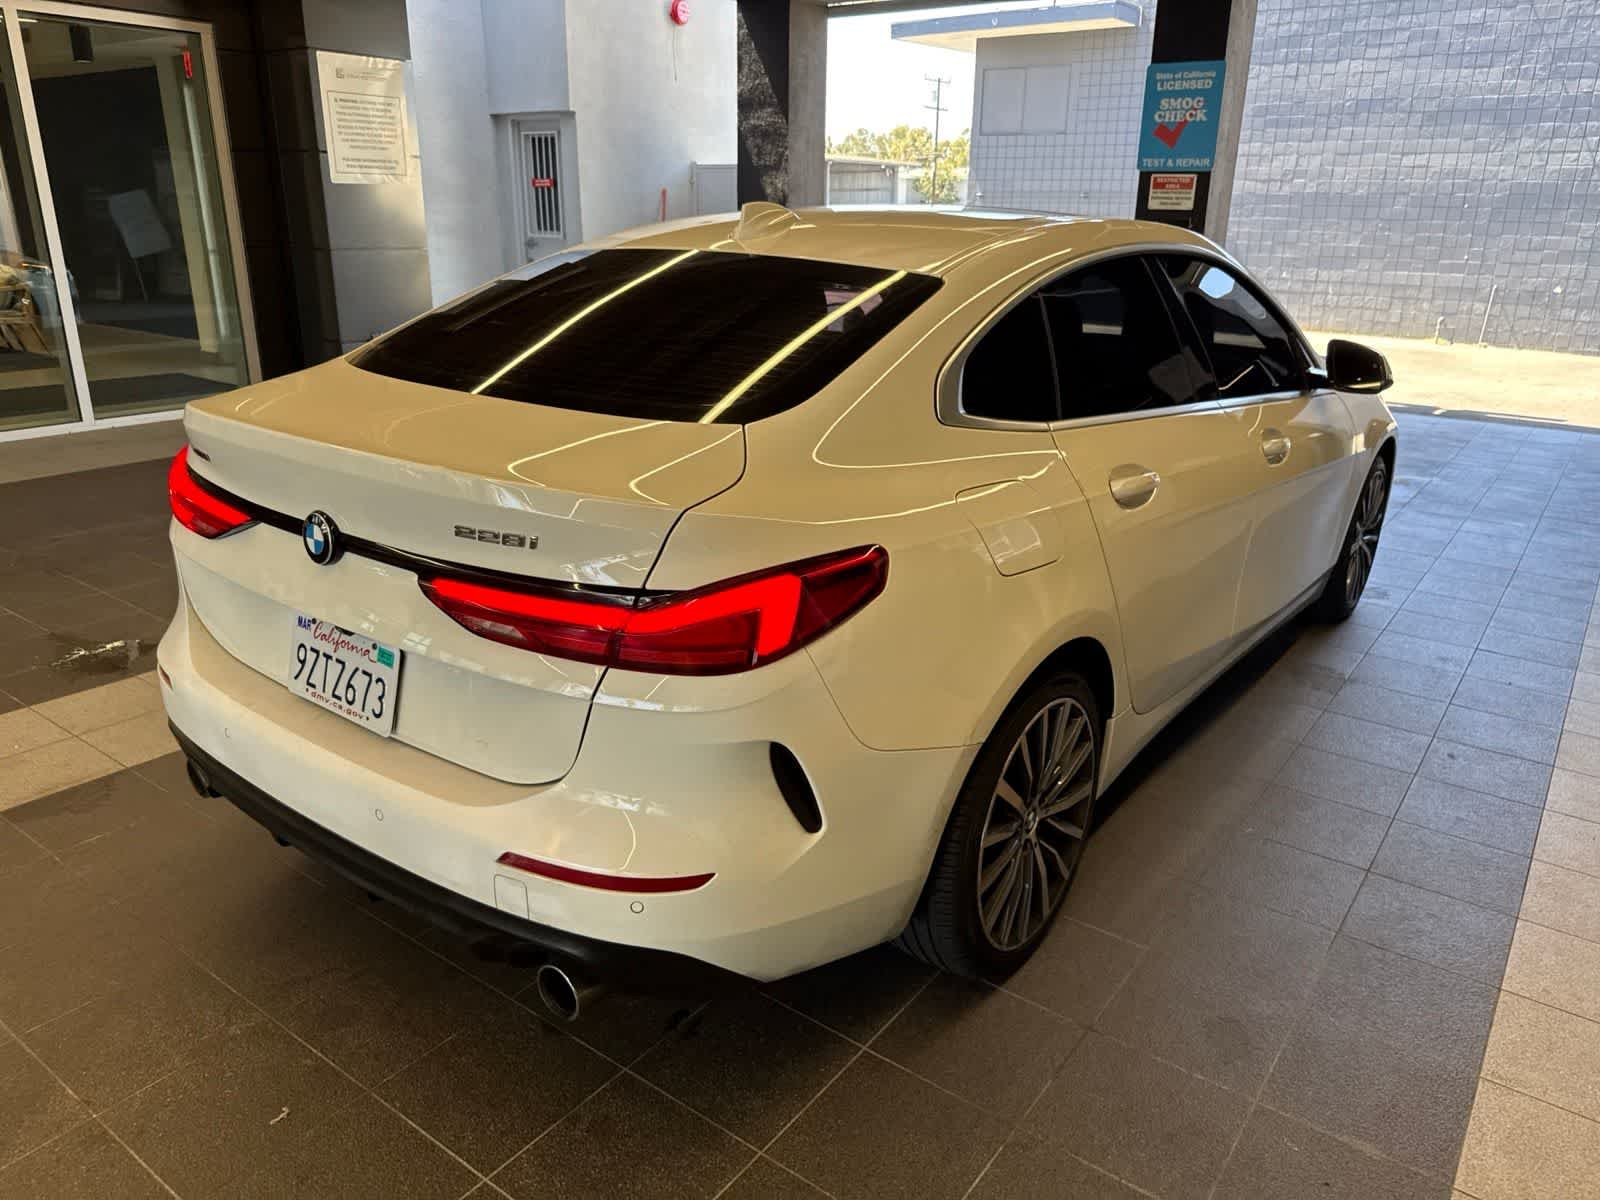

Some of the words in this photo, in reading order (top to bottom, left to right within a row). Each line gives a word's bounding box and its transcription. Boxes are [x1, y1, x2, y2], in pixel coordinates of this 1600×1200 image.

[1156, 72, 1174, 80] State
[1183, 71, 1217, 79] California
[1157, 79, 1213, 91] LICENSED
[1160, 96, 1205, 110] SMOG
[1153, 109, 1208, 123] CHECK
[1142, 158, 1166, 169] TEST
[1167, 158, 1175, 168] &
[1176, 157, 1210, 168] REPAIR
[454, 525, 539, 550] 228i
[313, 620, 377, 663] California
[294, 642, 387, 719] 9ZTZ673
[311, 690, 364, 720] dmv.ca.gov
